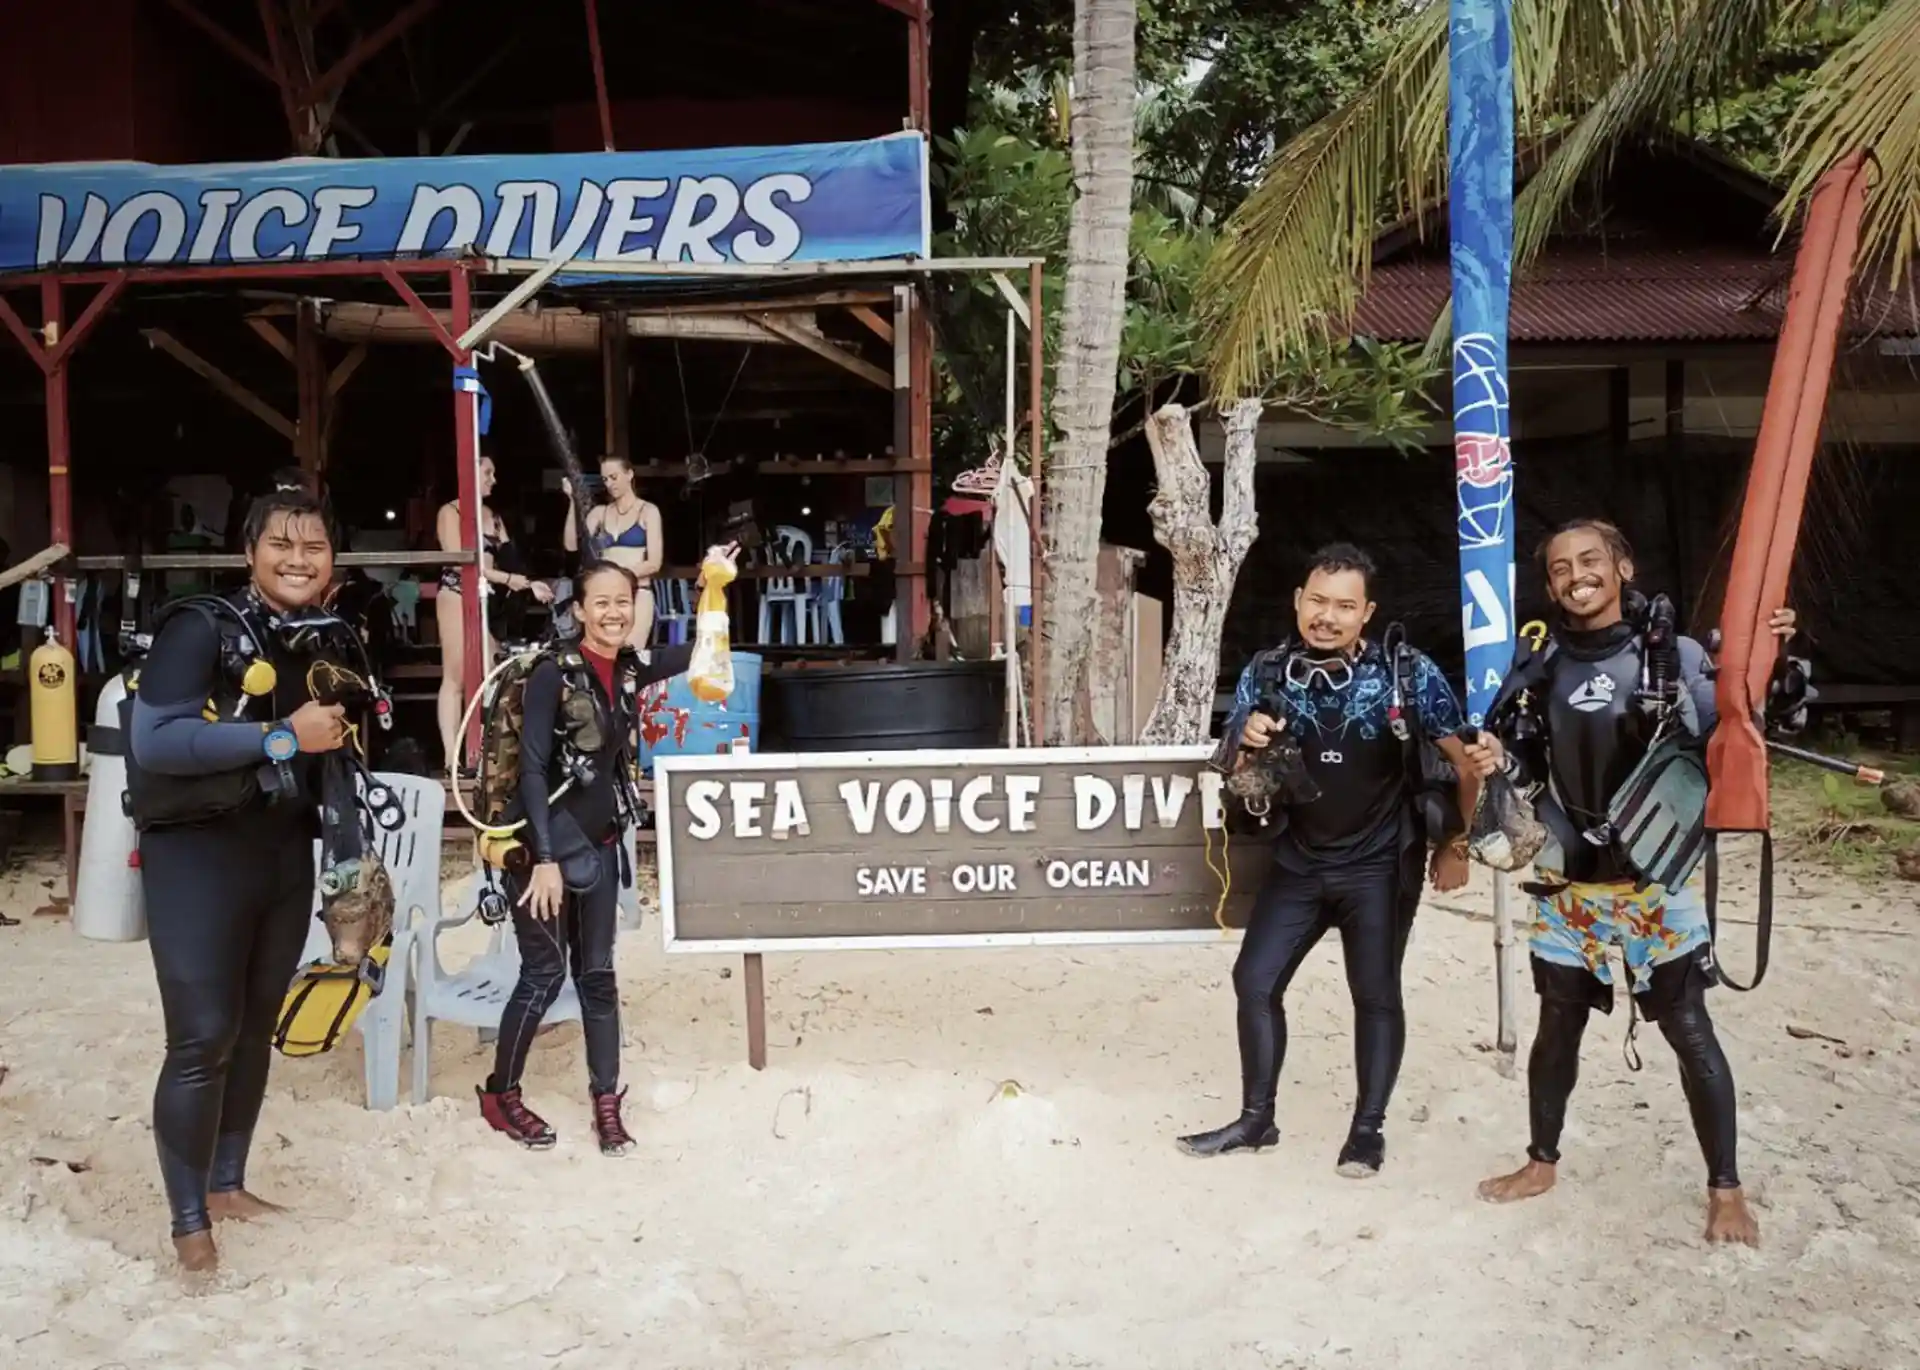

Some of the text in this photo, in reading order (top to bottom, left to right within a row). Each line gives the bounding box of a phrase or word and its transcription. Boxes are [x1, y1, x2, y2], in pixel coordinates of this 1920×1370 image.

[36, 173, 813, 268] VOICE DIVERS
[685, 773, 1225, 841] SEA VOICE DIVE
[856, 858, 1150, 897] SAVE OUR OCEAN
